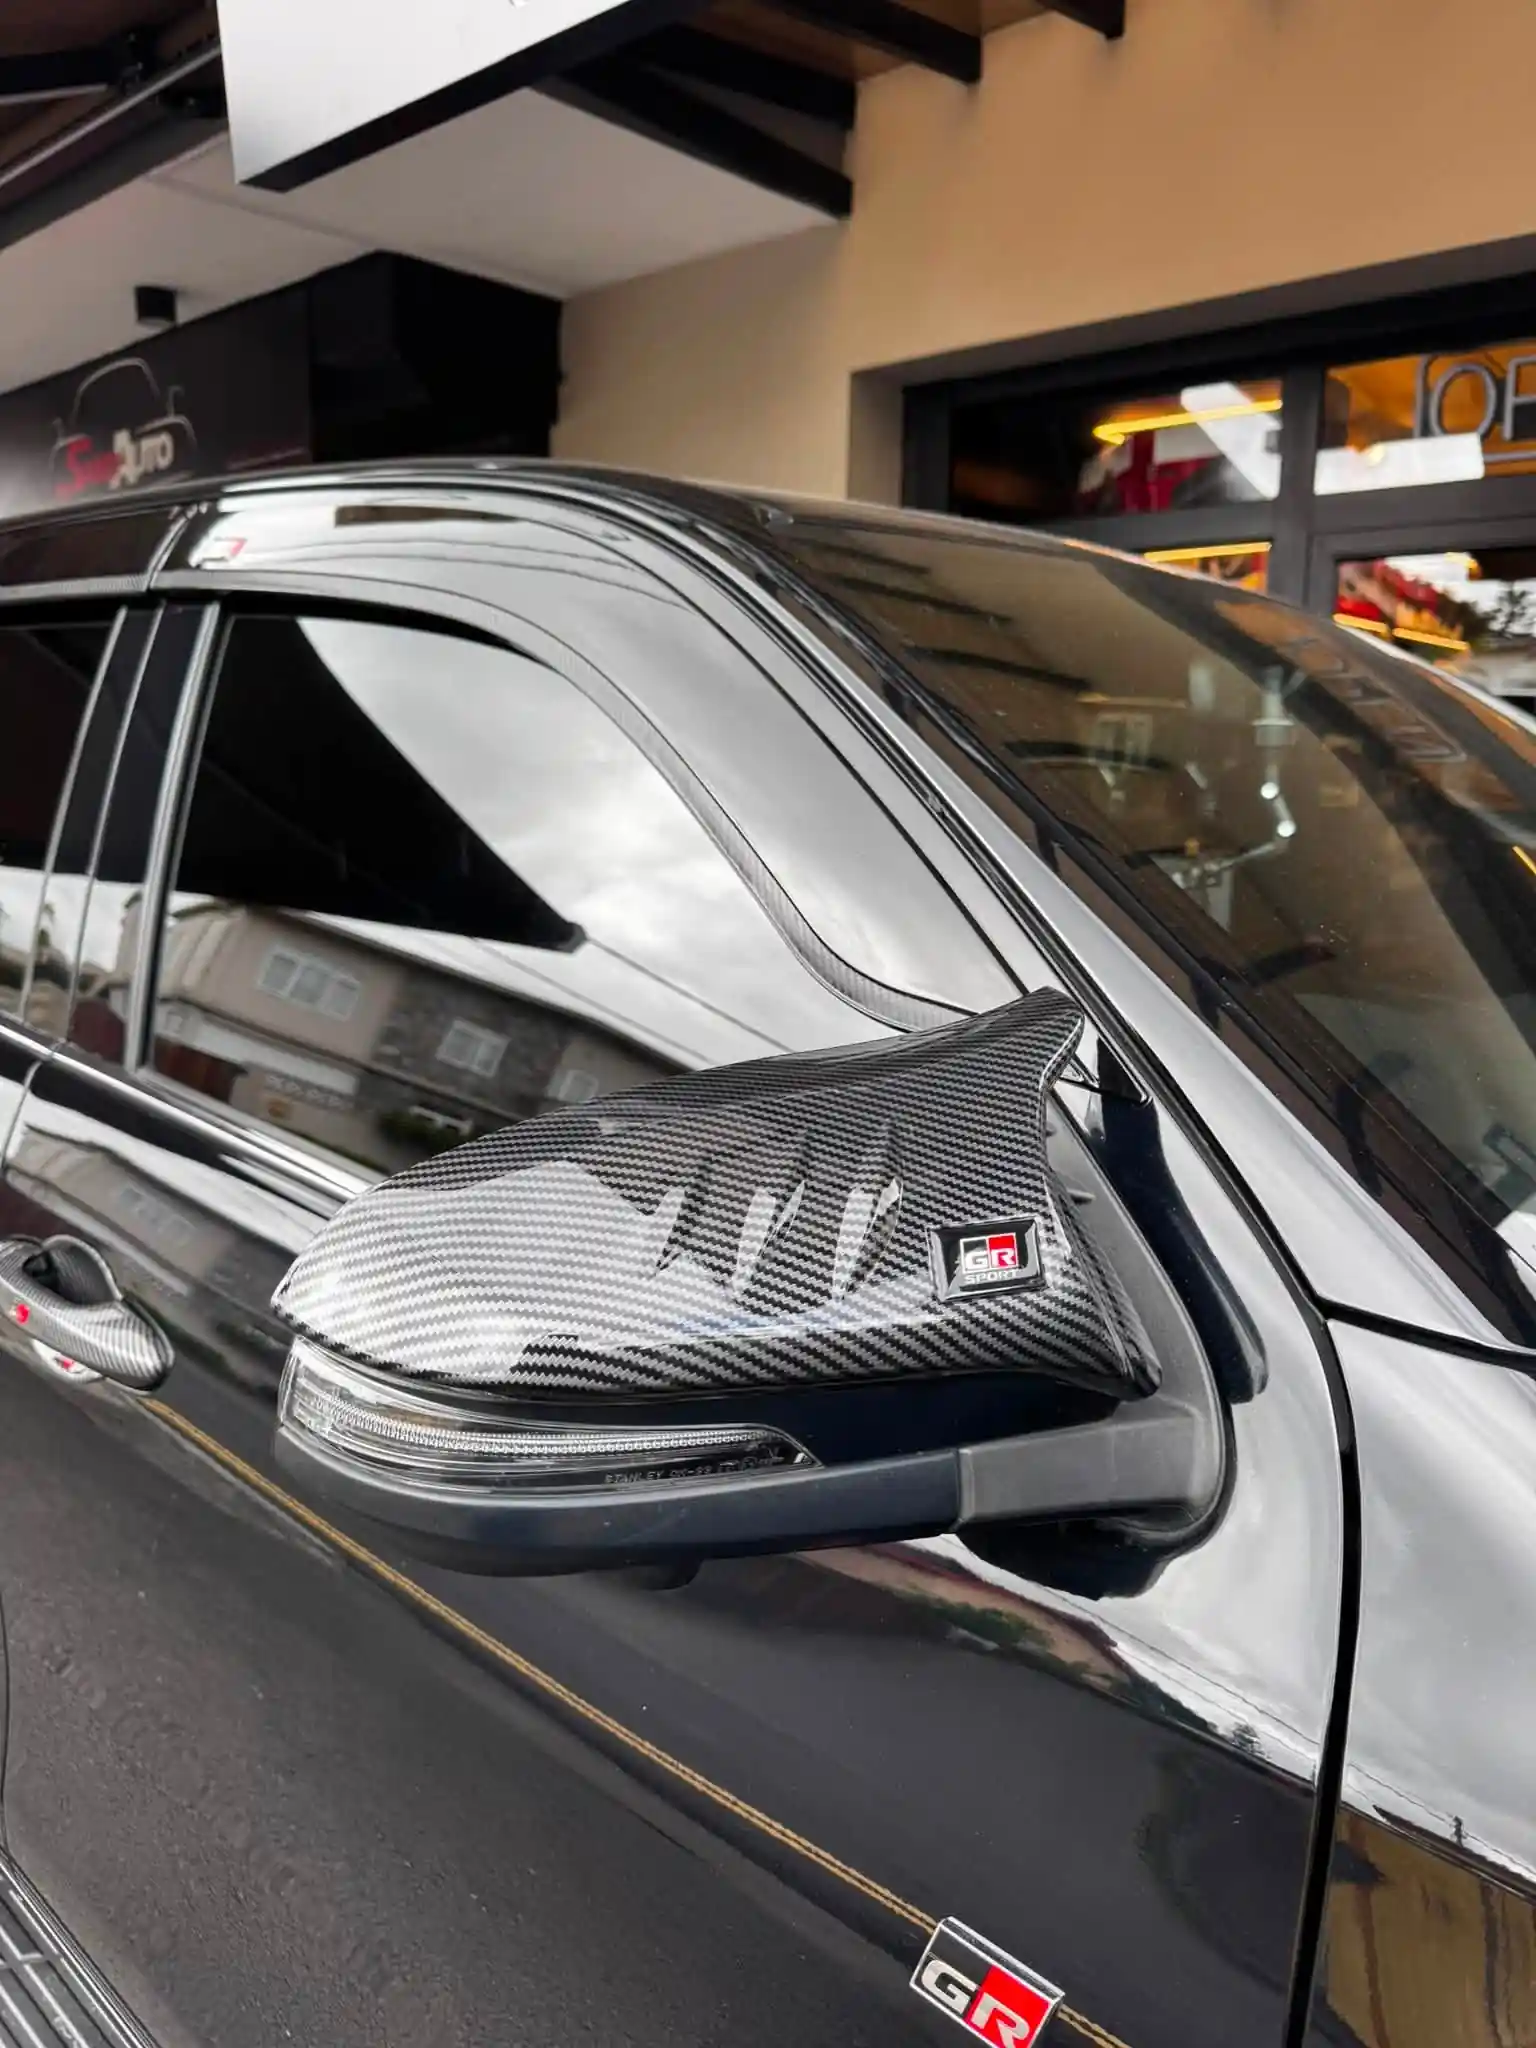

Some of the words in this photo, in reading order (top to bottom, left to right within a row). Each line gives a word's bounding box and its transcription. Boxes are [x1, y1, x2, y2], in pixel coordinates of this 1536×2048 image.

[964, 1248, 1016, 1270] GR
[963, 1270, 1018, 1284] SPORT
[921, 1959, 1031, 2048] GR
